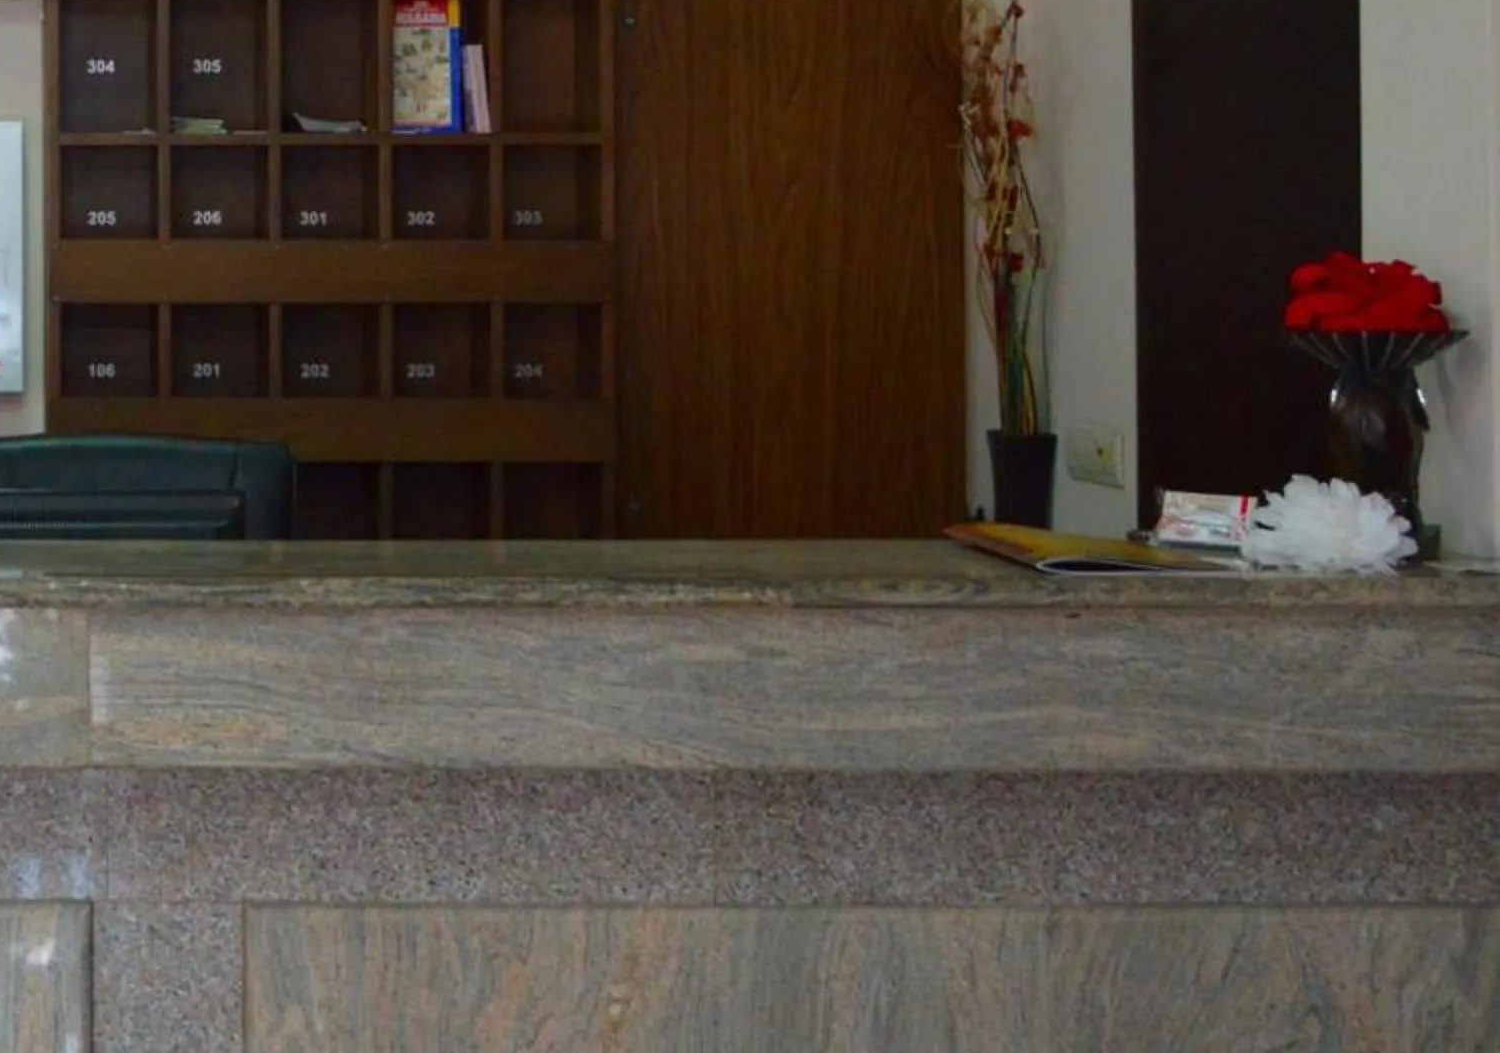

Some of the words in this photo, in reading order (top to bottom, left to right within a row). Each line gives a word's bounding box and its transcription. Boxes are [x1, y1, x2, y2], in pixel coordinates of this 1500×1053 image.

[87, 59, 116, 74] 304
[193, 58, 222, 74] 305
[87, 210, 117, 226] 205
[193, 210, 222, 225] 206
[299, 210, 328, 226] 301
[407, 210, 436, 226] 302
[193, 362, 221, 378] 201
[300, 363, 330, 379] 202
[406, 363, 436, 379] 203
